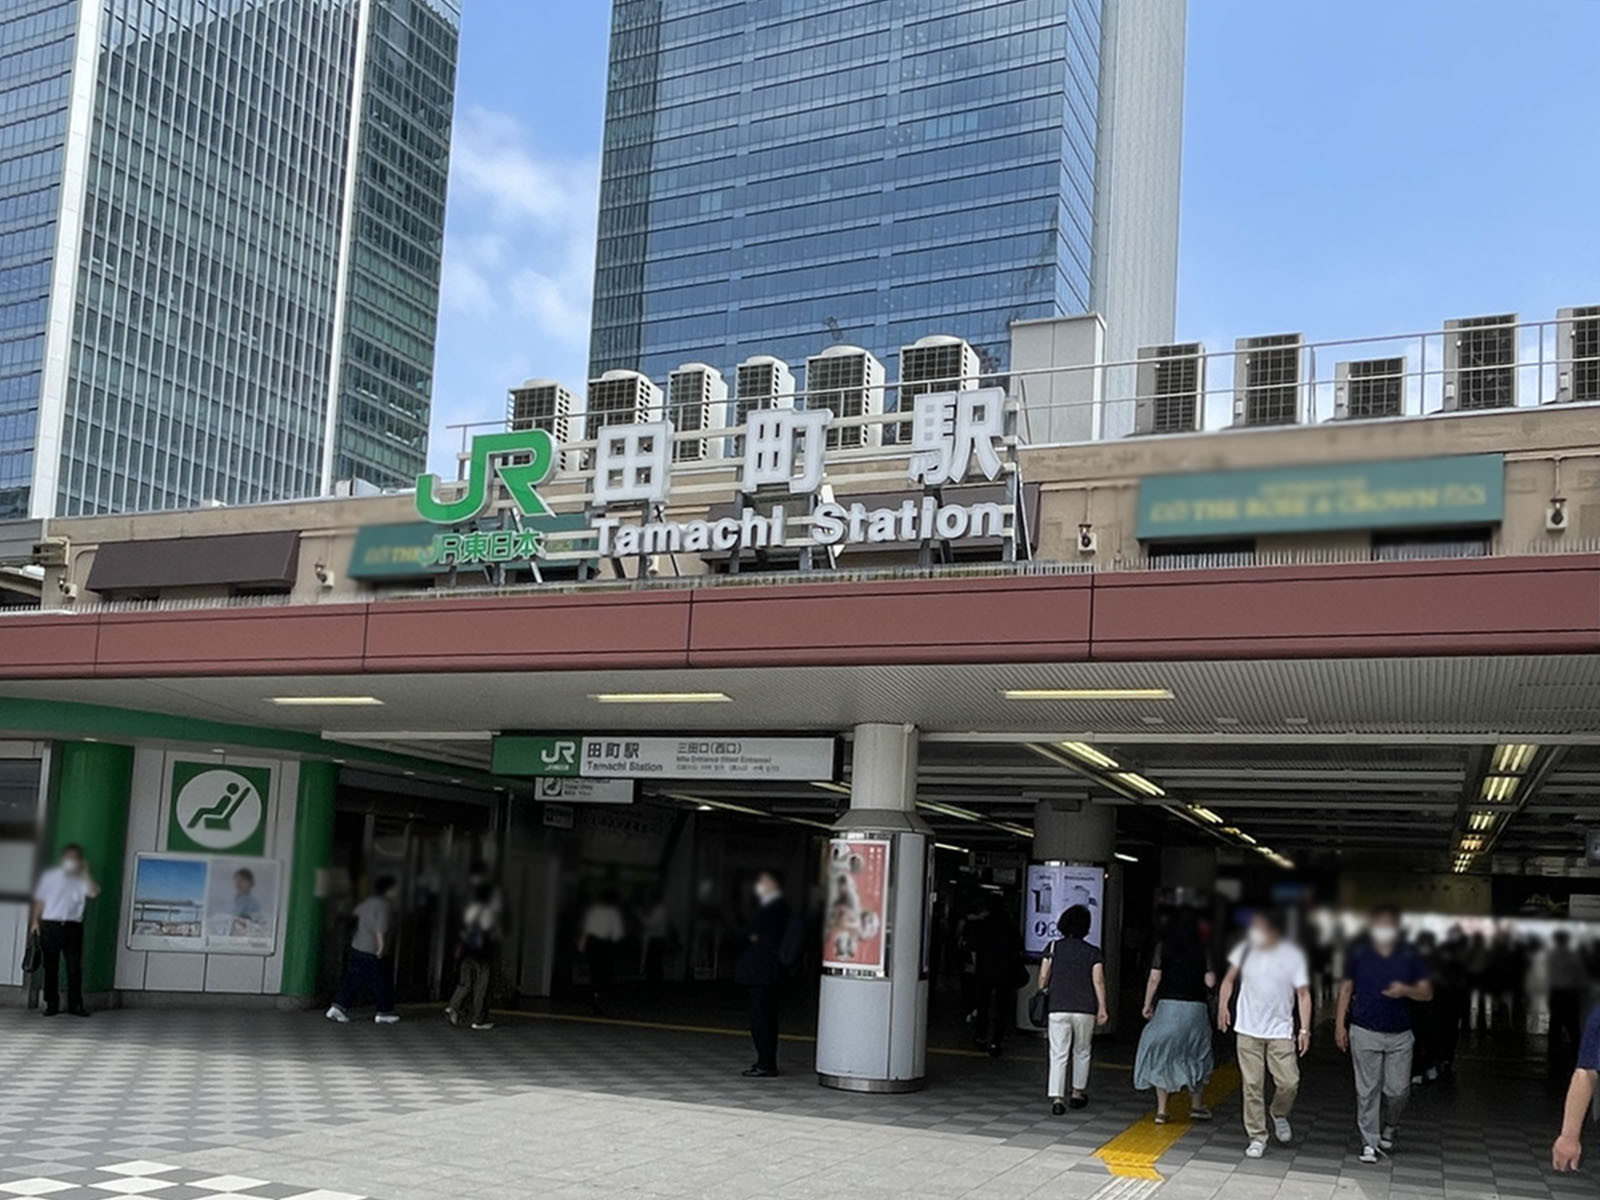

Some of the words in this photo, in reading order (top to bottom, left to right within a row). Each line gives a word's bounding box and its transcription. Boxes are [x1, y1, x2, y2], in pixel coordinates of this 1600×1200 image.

[595, 387, 1007, 504] 田町駅
[415, 428, 558, 525] JR
[592, 505, 785, 559] Tamachi
[811, 496, 1003, 546] Station
[419, 528, 541, 566] JR東日本
[541, 741, 576, 764] JR
[587, 742, 640, 759] 田町駅
[587, 760, 627, 771] Tamachi
[629, 761, 664, 772] Station
